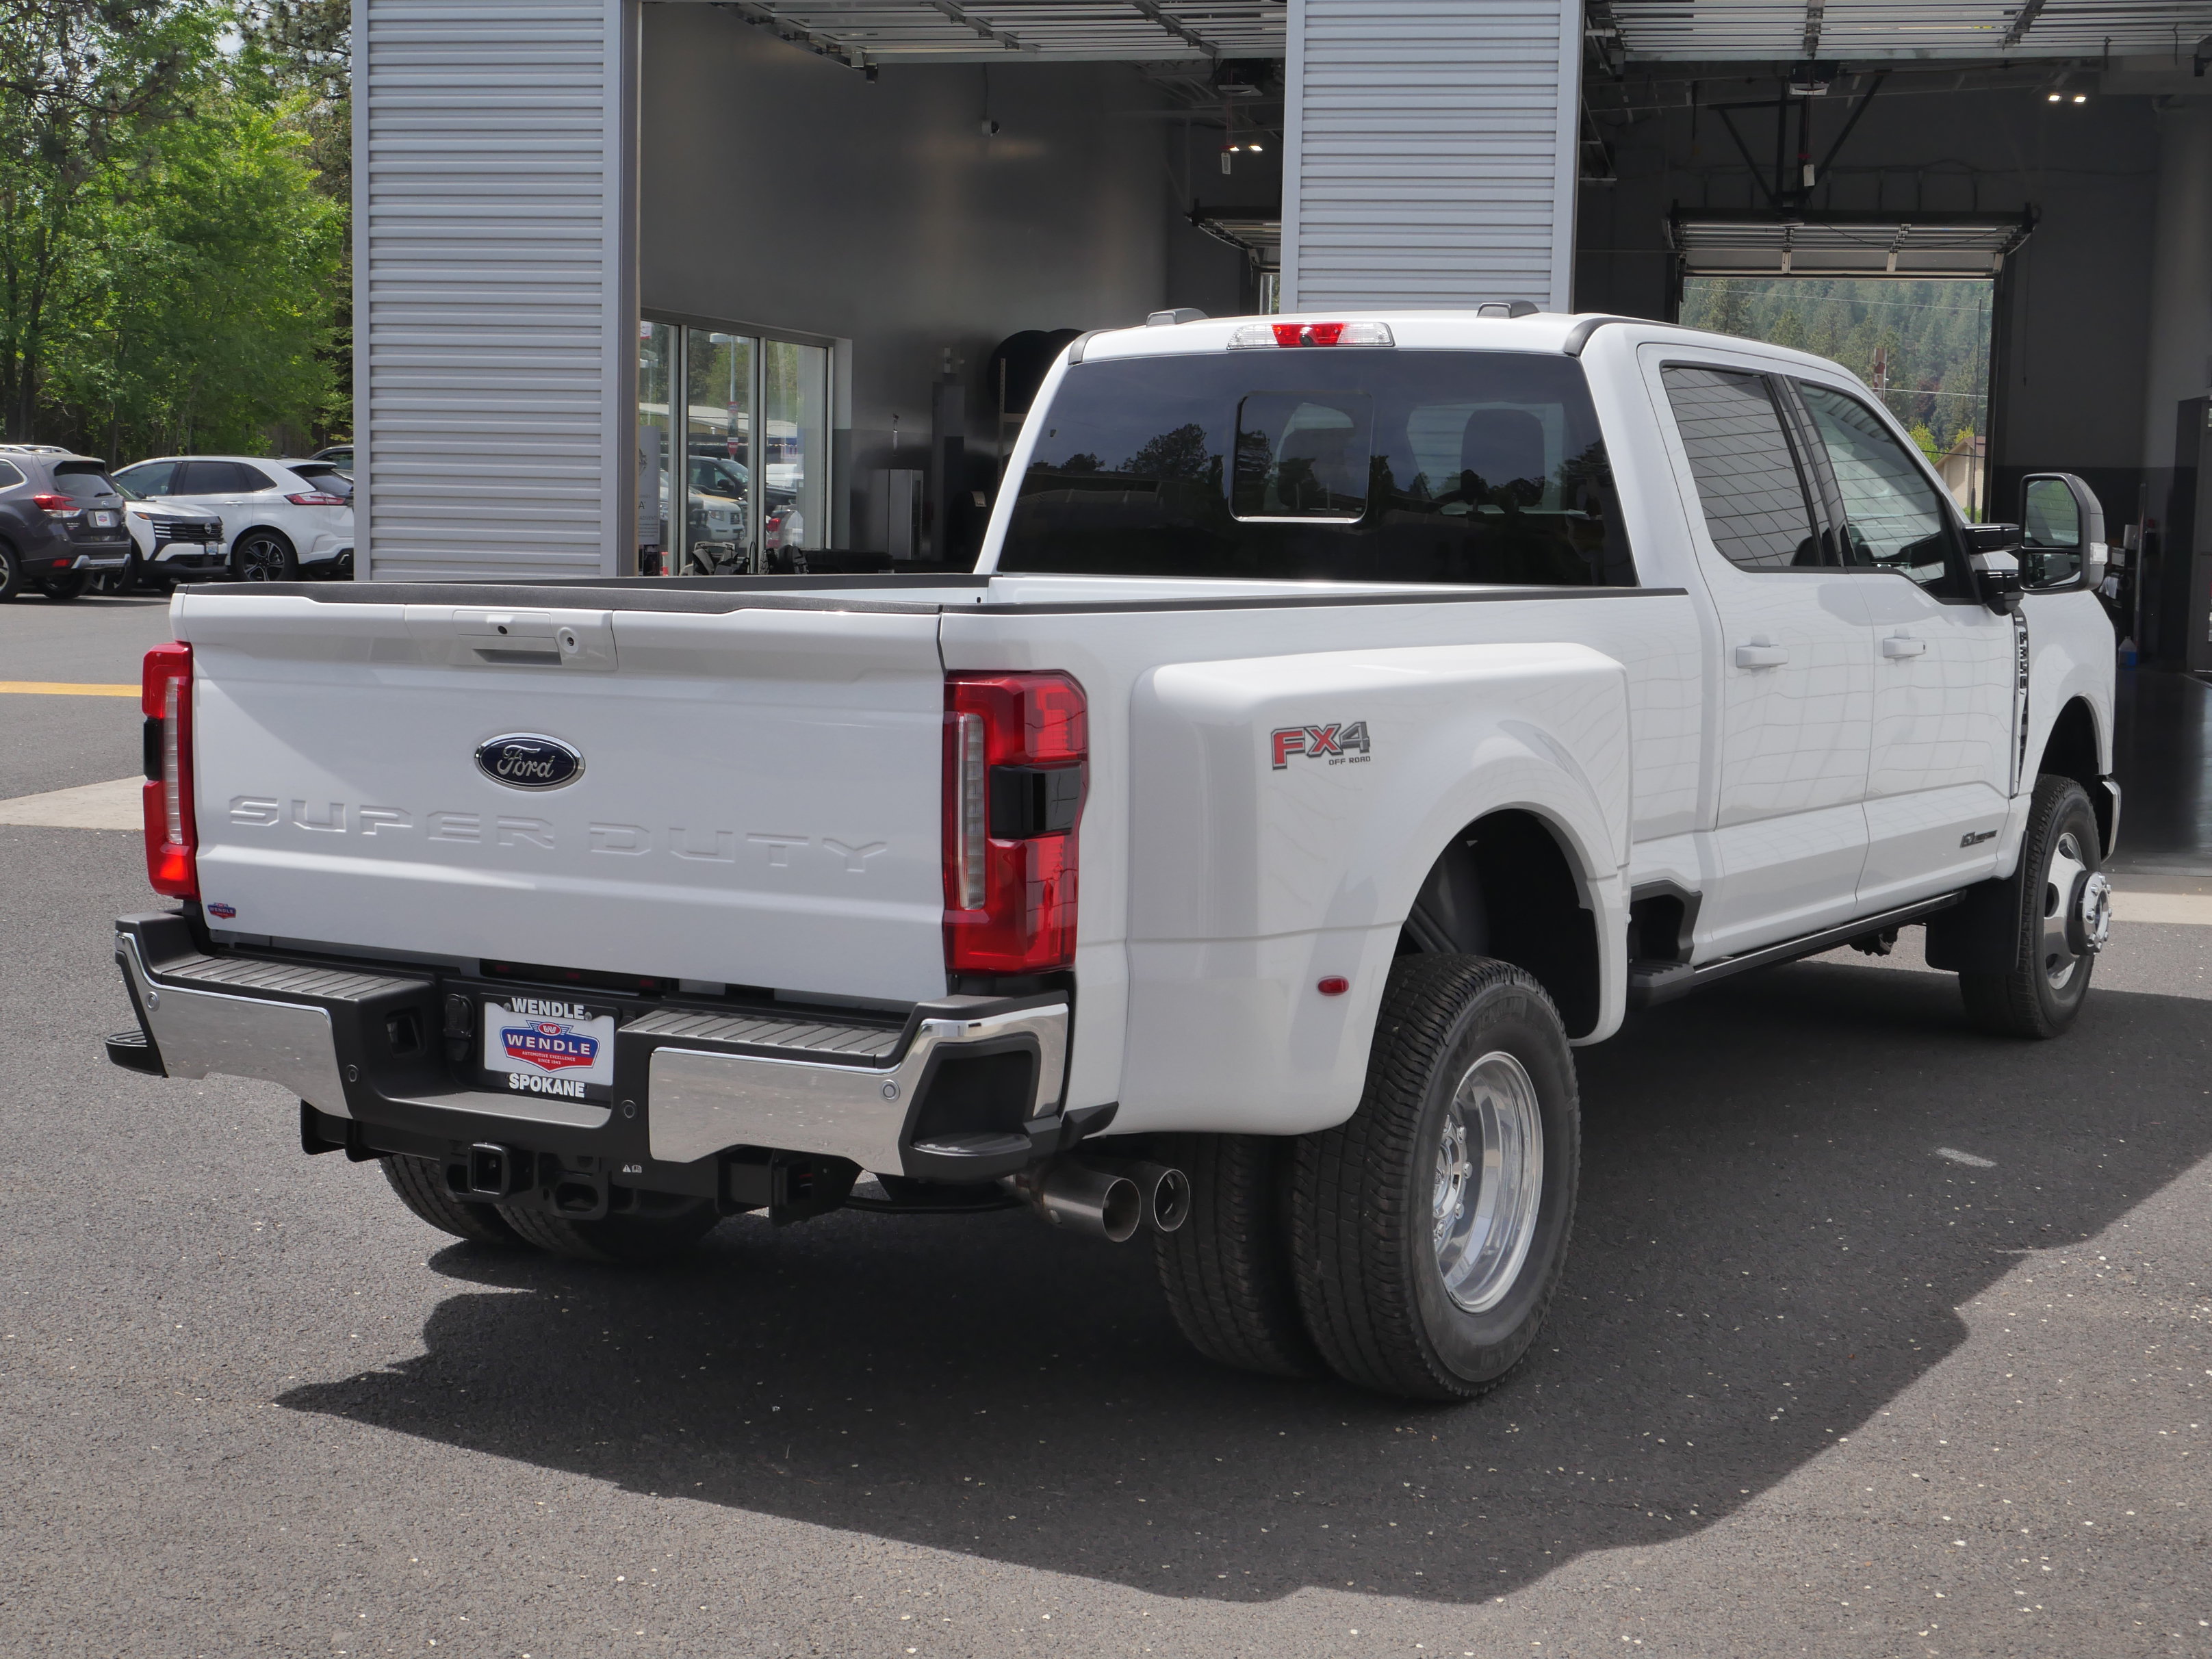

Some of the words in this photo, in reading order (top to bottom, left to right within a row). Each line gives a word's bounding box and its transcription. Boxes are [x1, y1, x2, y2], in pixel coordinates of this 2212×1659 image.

[1271, 721, 1371, 771] FX4
[496, 744, 556, 778] Ford
[1328, 758, 1346, 766] OFF
[1349, 756, 1372, 764] ROAD
[229, 795, 555, 849] SUPER
[589, 822, 888, 872] DUTY
[511, 997, 584, 1020] WENDLE
[506, 1033, 591, 1055] WENDLE
[509, 1073, 585, 1098] SPOKANE
